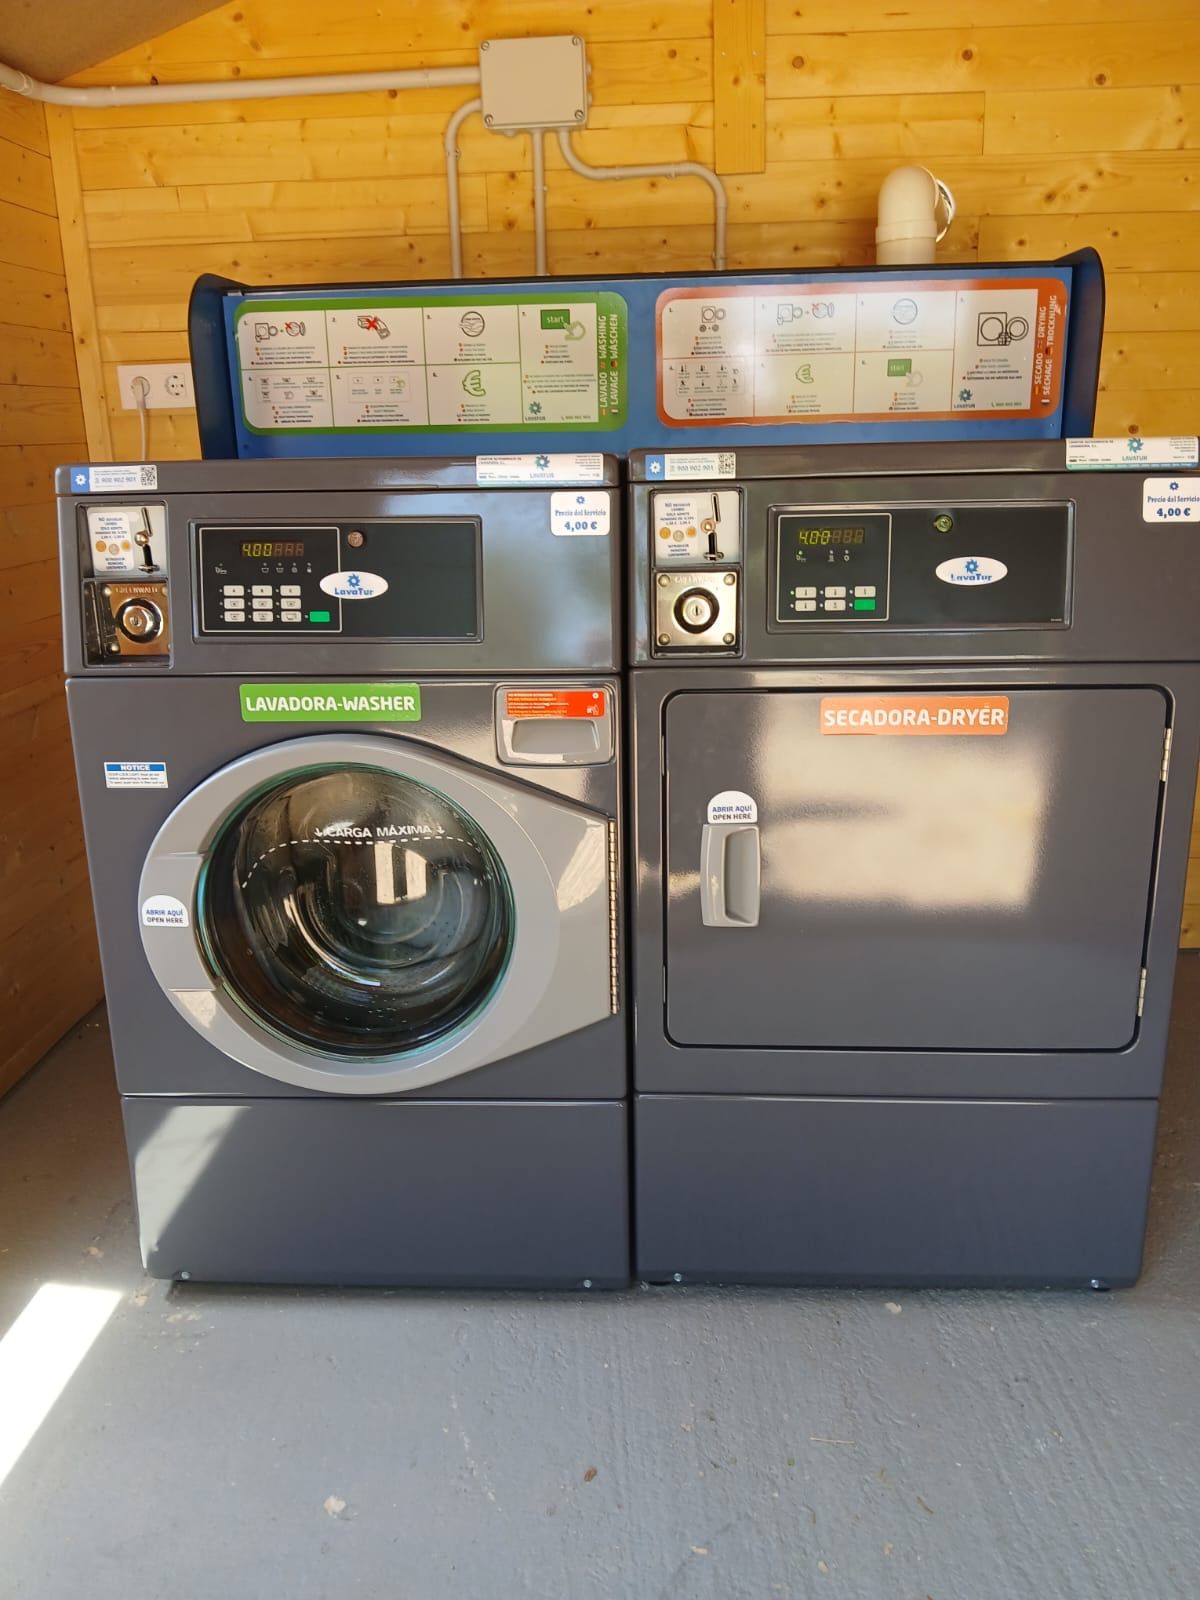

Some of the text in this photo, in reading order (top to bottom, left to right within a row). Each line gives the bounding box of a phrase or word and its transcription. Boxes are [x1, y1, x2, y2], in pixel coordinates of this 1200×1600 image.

[1037, 306, 1046, 338] DRYING
[1046, 295, 1057, 346] TROCKNUNG
[598, 316, 607, 359] WASHING
[1034, 352, 1044, 385] SECADO
[600, 372, 608, 408] LAVADO
[610, 370, 618, 405] LAVAGE
[1156, 507, 1191, 519] 4,00 €
[564, 521, 598, 532] 4,00 €
[950, 573, 992, 581] LavaTur
[334, 587, 374, 596] LavaTur
[245, 695, 416, 713] LAVADORA-WASHER
[824, 707, 1004, 727] SECADORA-DRYER
[735, 804, 752, 813] AQUÍ
[326, 824, 432, 838] CARGA MÁXIMA
